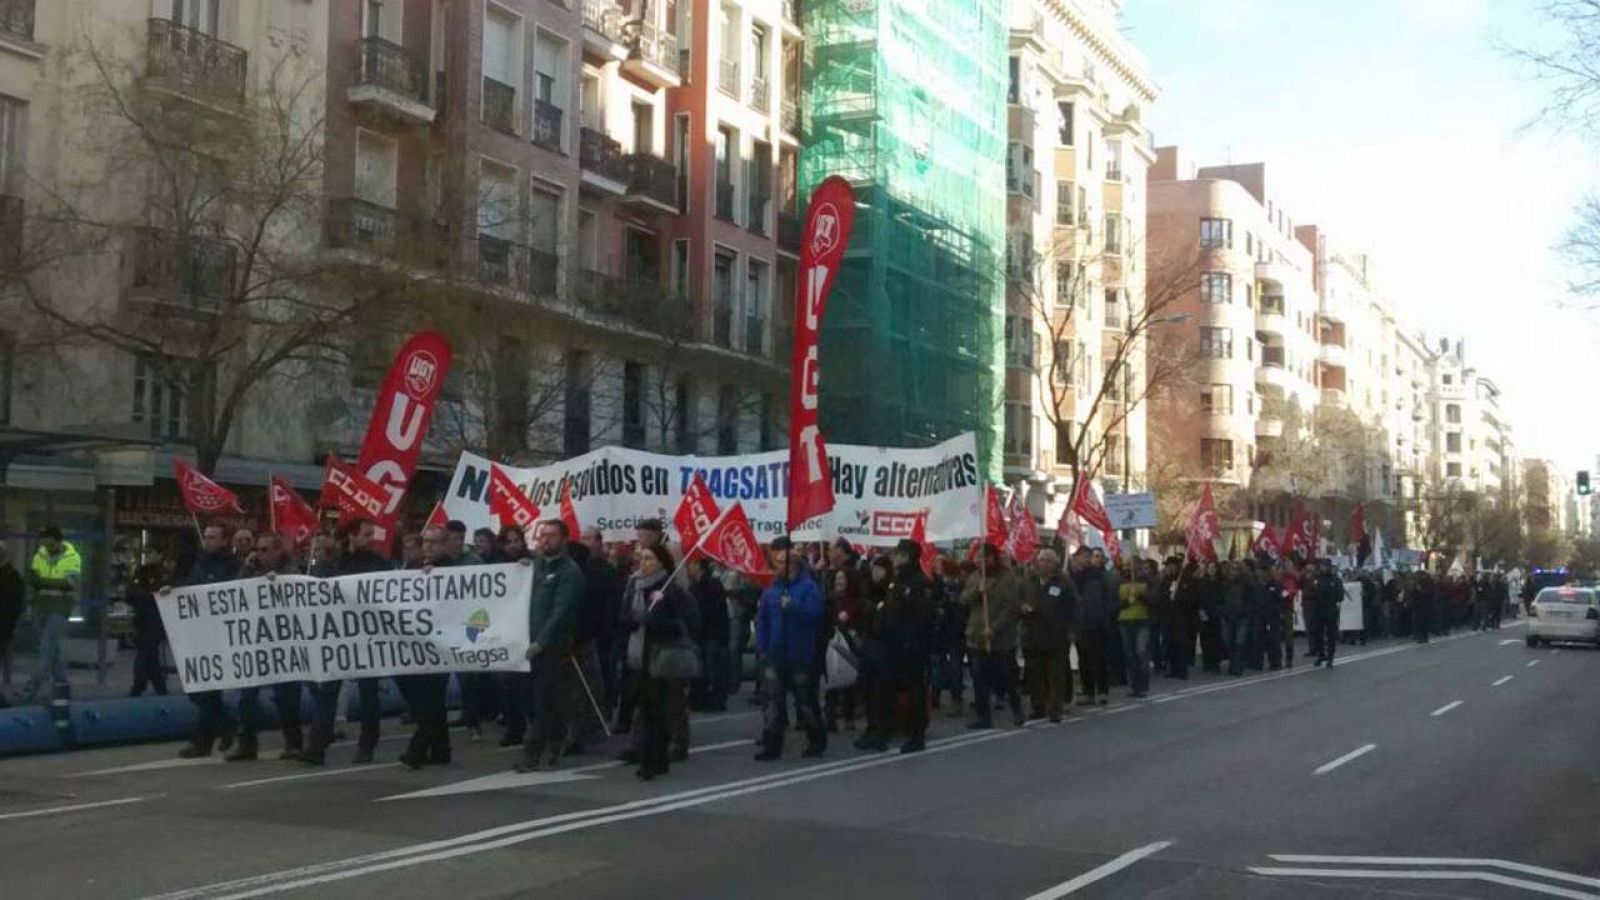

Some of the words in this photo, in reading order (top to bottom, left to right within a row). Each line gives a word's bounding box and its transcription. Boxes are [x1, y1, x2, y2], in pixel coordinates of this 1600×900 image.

[365, 391, 426, 540] UG
[456, 464, 493, 505] N
[529, 477, 556, 507] los
[555, 458, 637, 502] despidos
[640, 465, 669, 496] en
[829, 456, 868, 499] Hay
[874, 452, 976, 499] alternativas
[178, 595, 200, 620] EN
[209, 588, 249, 616] ESTA
[258, 579, 346, 611] EMPRESA
[356, 571, 506, 604] NECESITAMOS
[224, 609, 443, 647] TRABAJADORES.
[184, 654, 223, 684] NOS
[232, 646, 311, 679] SOBRAN
[322, 637, 448, 673] POLÍTICOS.
[450, 646, 509, 668] Tragsa
